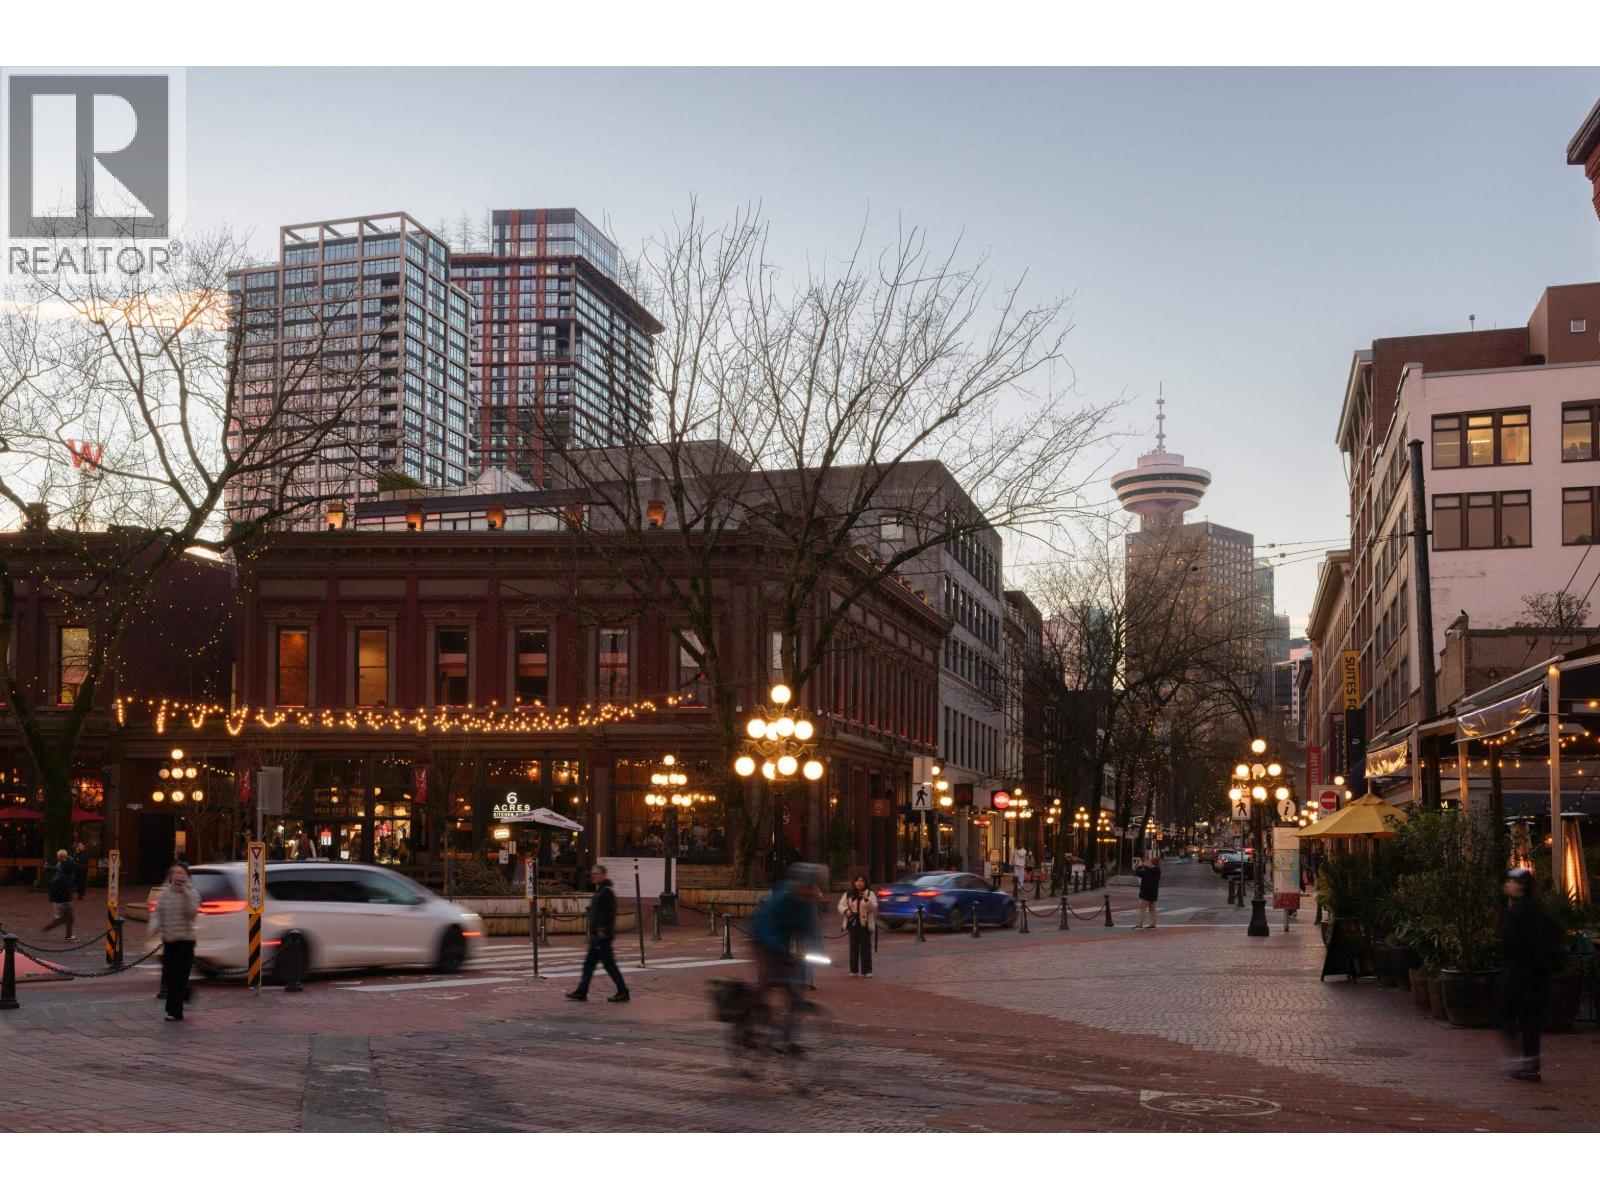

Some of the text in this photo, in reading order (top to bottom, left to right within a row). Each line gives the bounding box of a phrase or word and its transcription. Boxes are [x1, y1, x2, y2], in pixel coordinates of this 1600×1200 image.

[66, 438, 104, 471] W
[1345, 656, 1356, 695] SUITES
[506, 792, 518, 804] 6
